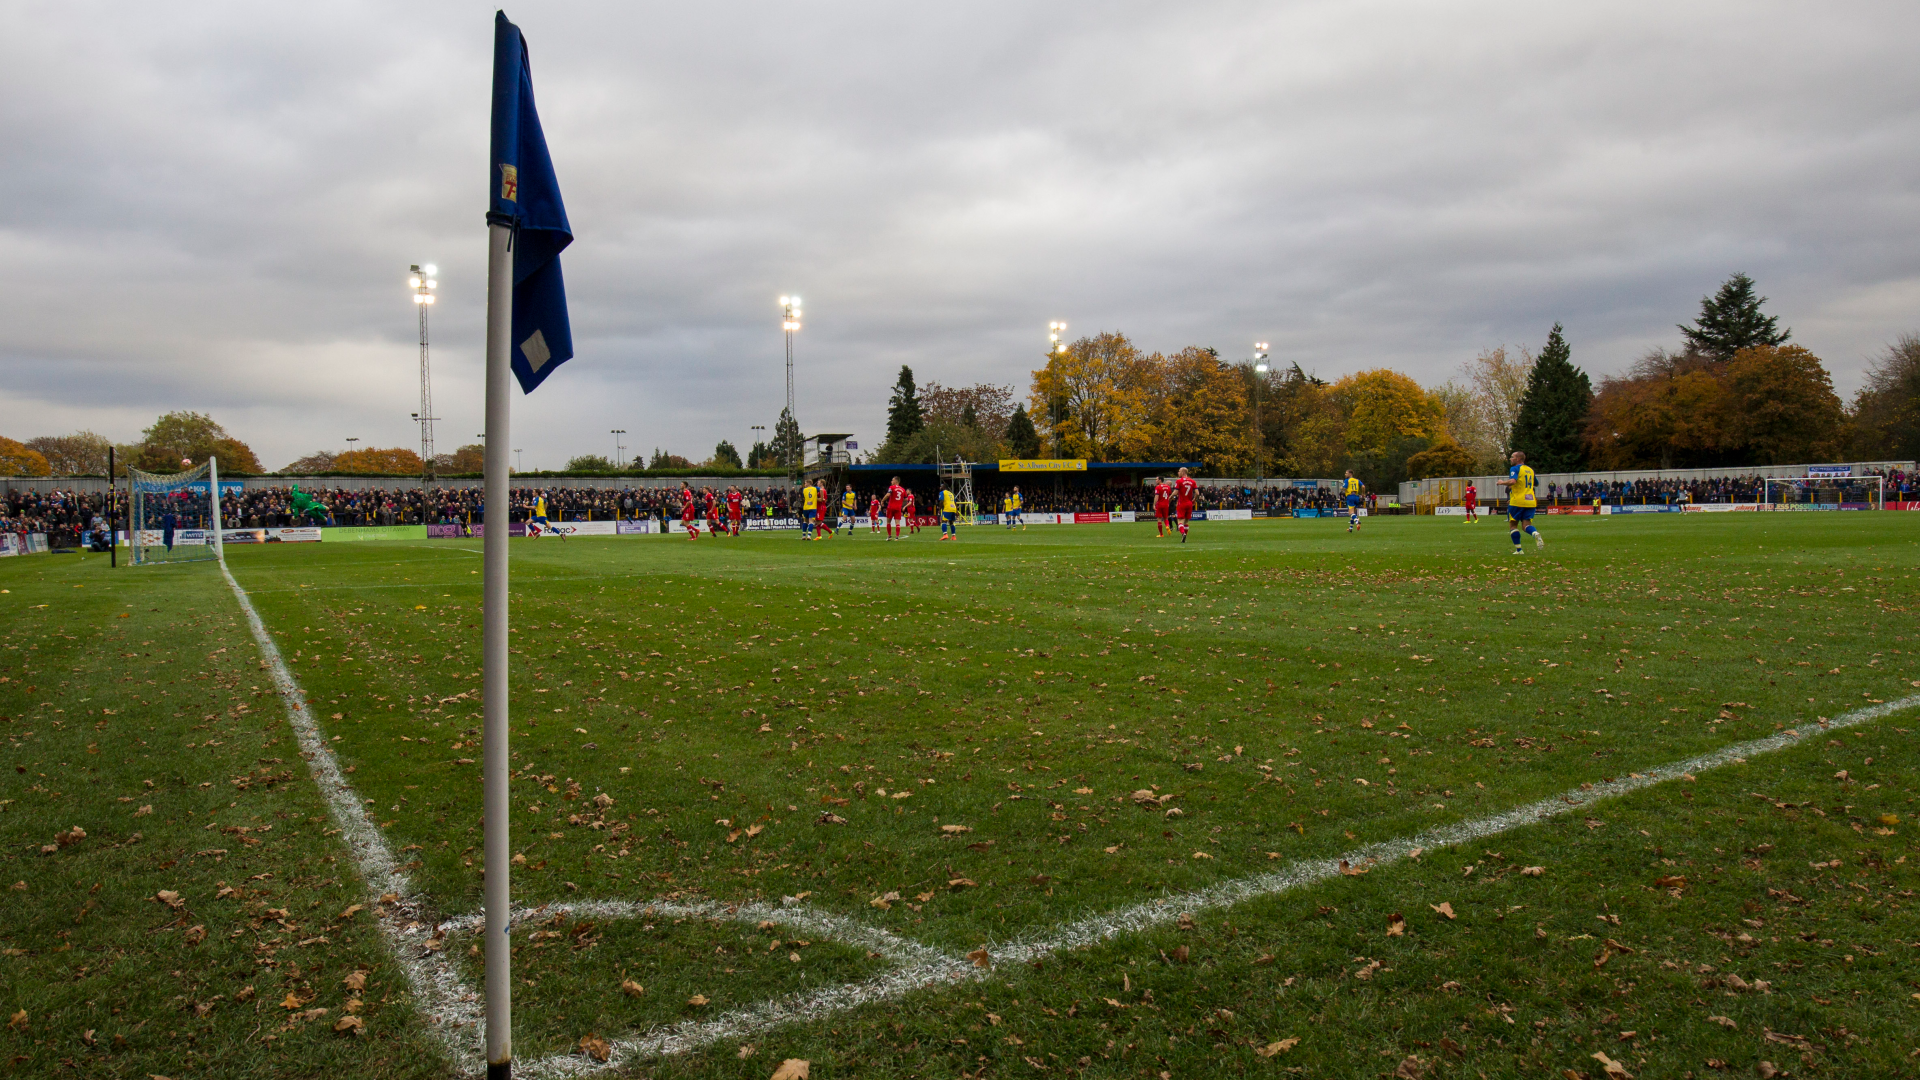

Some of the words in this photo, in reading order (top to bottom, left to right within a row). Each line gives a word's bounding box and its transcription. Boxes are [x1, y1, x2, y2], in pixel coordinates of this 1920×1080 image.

[1048, 462, 1061, 470] City
[1524, 475, 1533, 489] 14
[1184, 485, 1191, 497] 7
[1351, 483, 1358, 491] 11
[808, 491, 813, 499] 6
[895, 491, 902, 501] 3
[746, 518, 768, 526] Herts
[769, 518, 787, 526] Tool
[788, 518, 801, 526] Co.
